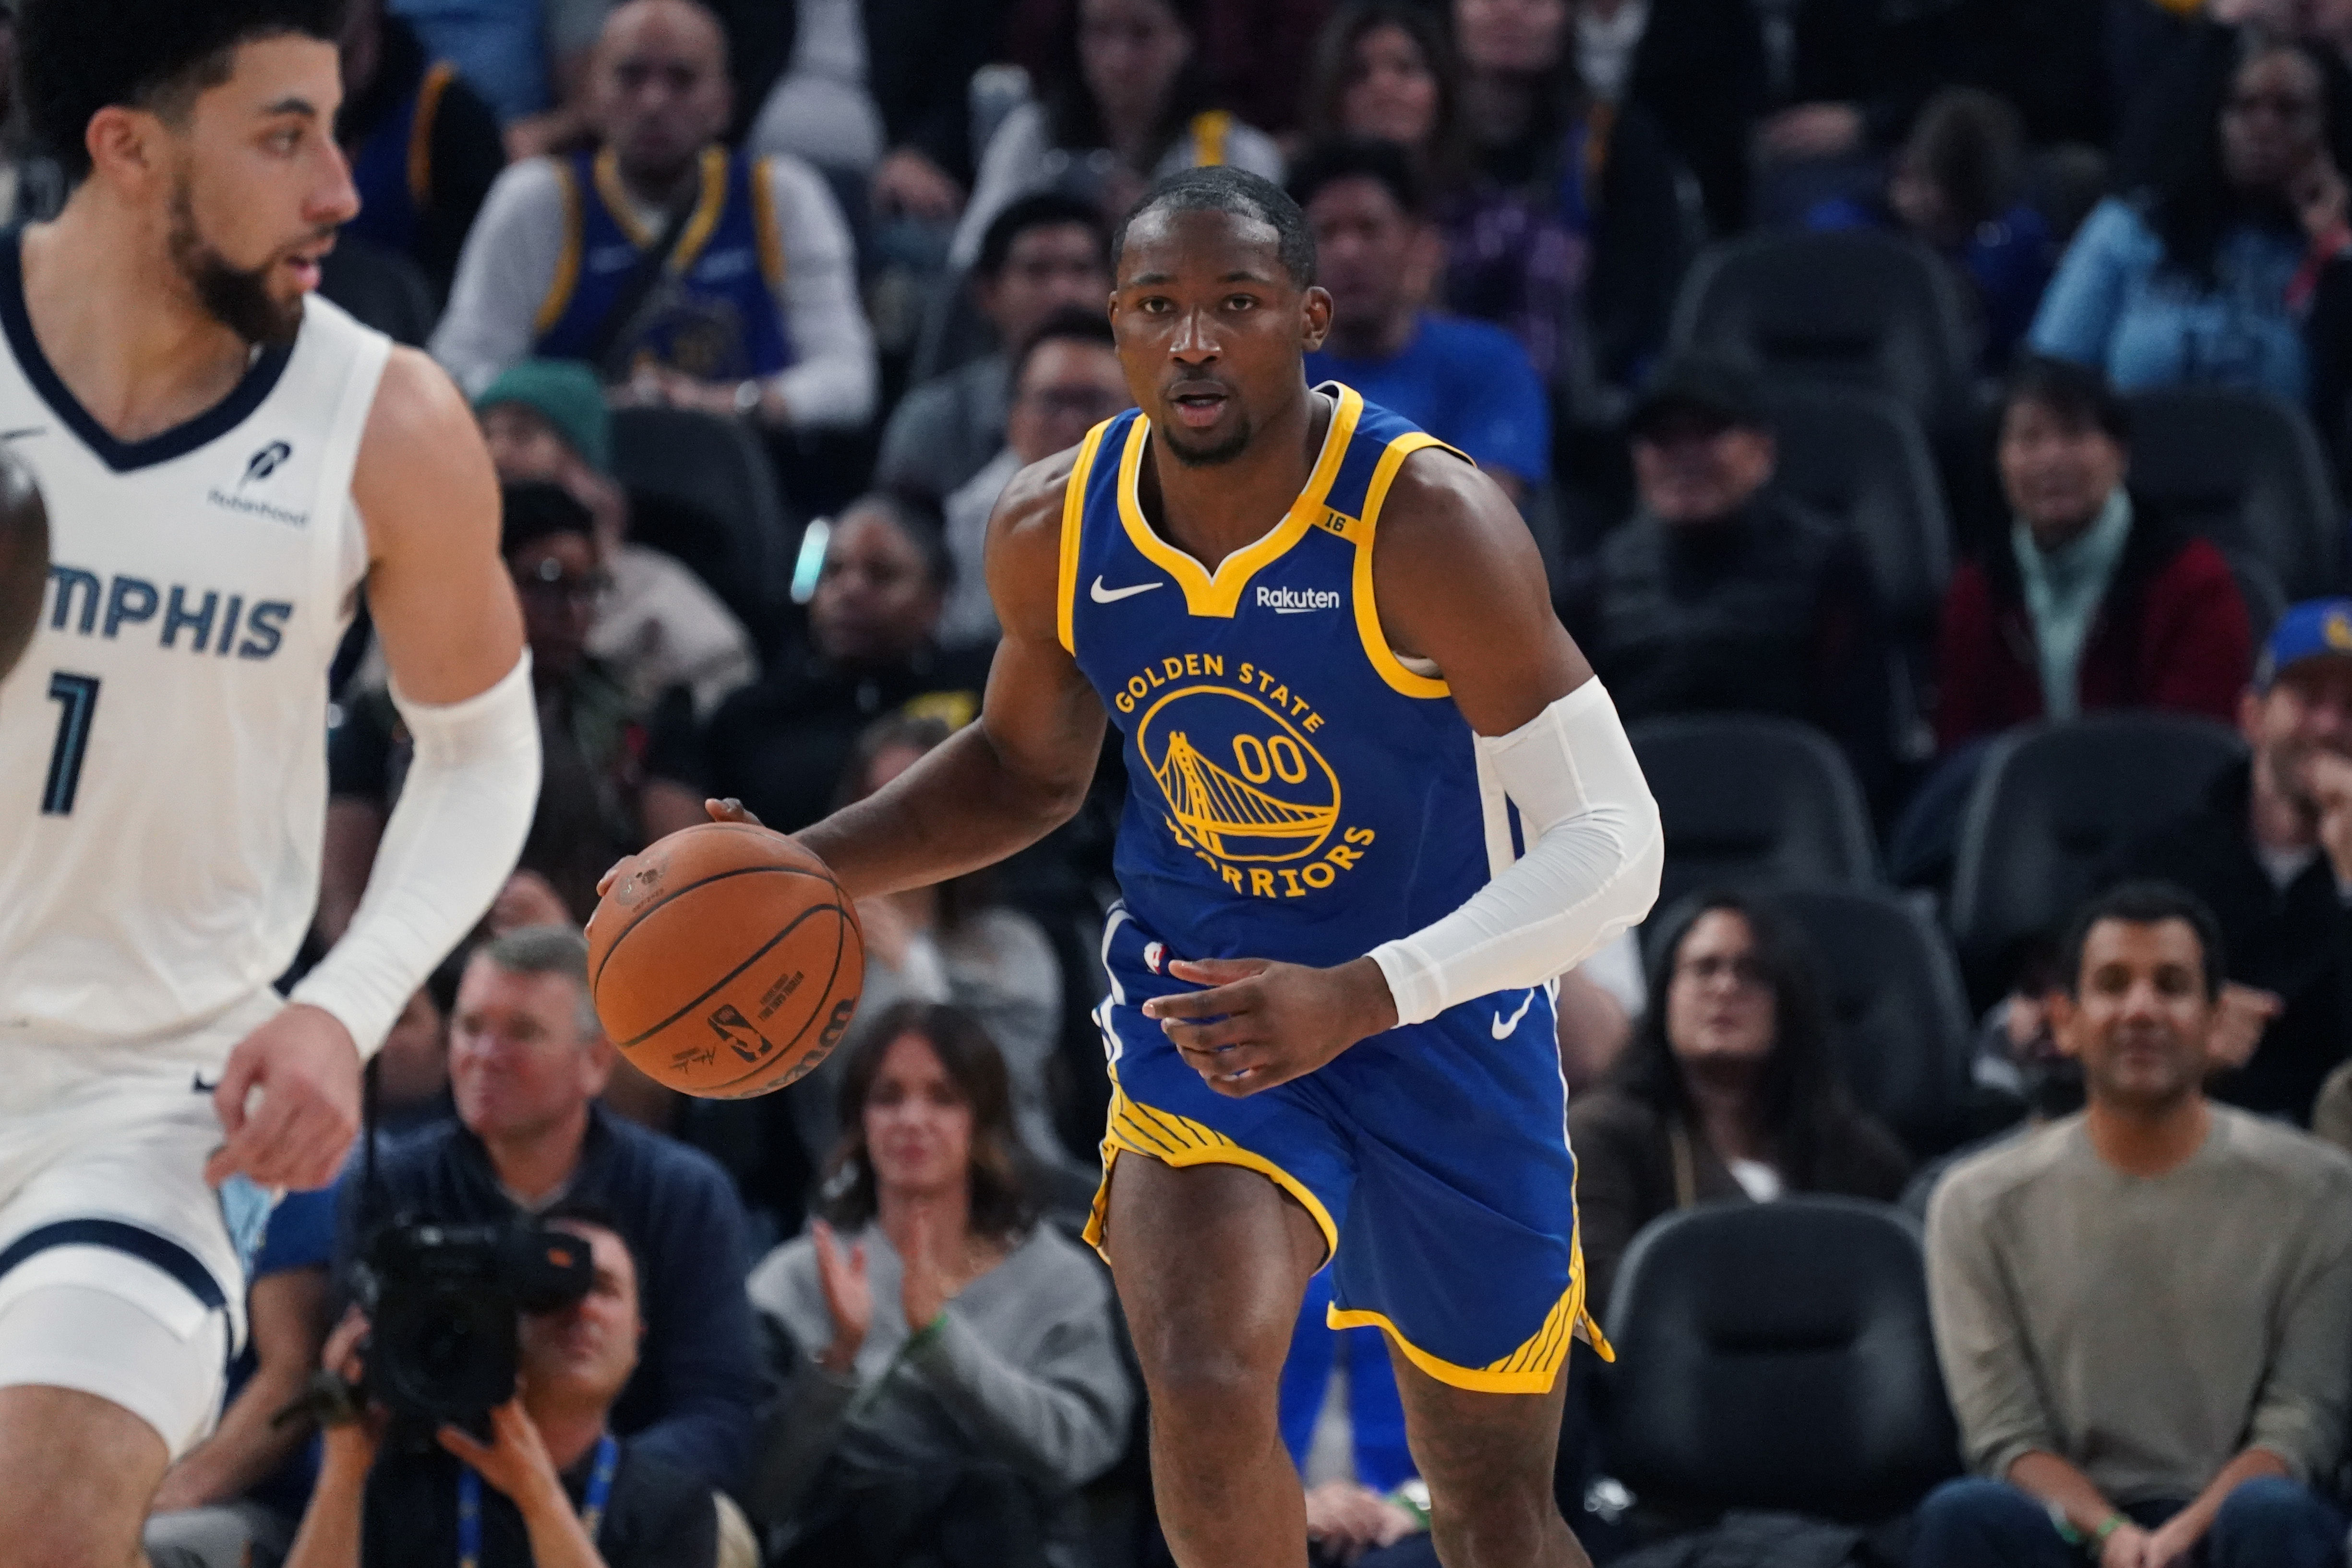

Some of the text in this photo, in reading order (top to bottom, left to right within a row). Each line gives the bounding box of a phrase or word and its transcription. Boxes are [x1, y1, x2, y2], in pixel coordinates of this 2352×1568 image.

[1325, 512, 1346, 532] 16
[1257, 586, 1340, 613] Rakuten
[1115, 654, 1325, 733] GOLDEN STATE
[41, 670, 101, 815] 1
[1232, 734, 1307, 784] 00
